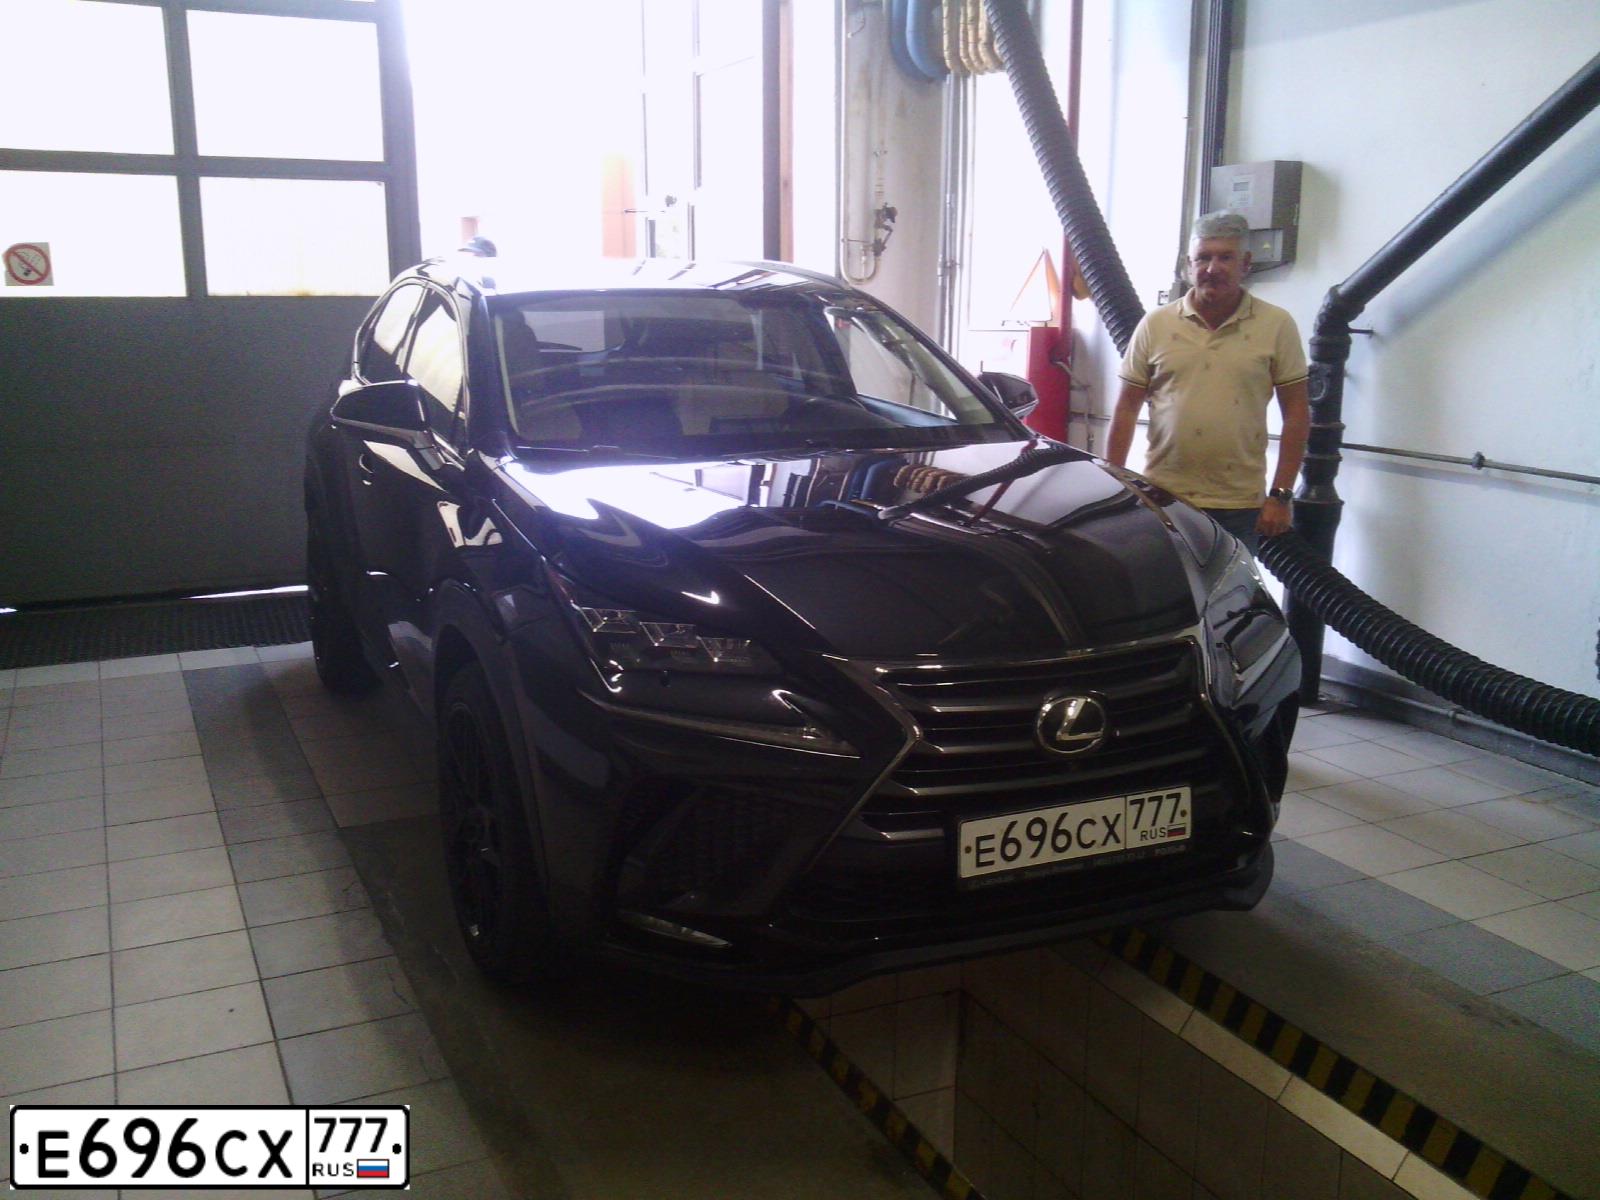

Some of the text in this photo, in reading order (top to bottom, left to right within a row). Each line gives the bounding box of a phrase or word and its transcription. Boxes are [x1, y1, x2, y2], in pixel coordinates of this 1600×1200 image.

[975, 792, 1182, 868] E696CX 777
[1140, 826, 1166, 842] RUS
